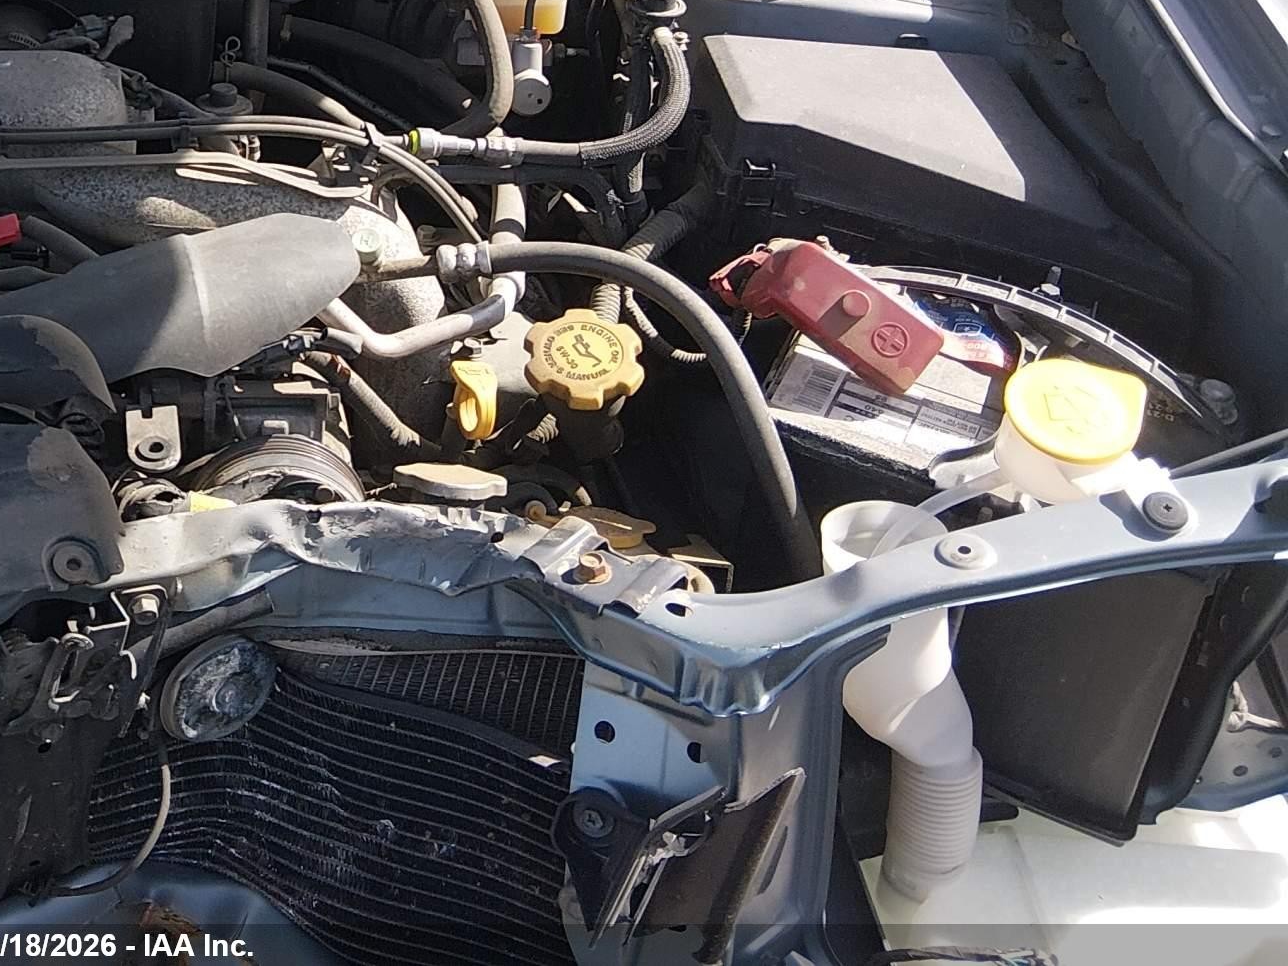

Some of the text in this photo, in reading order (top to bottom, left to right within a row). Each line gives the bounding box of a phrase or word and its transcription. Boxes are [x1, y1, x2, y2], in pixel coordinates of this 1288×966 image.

[580, 324, 620, 364] ENGINE OIL
[555, 346, 579, 369] 5W-30
[566, 368, 611, 381] MANUAL
